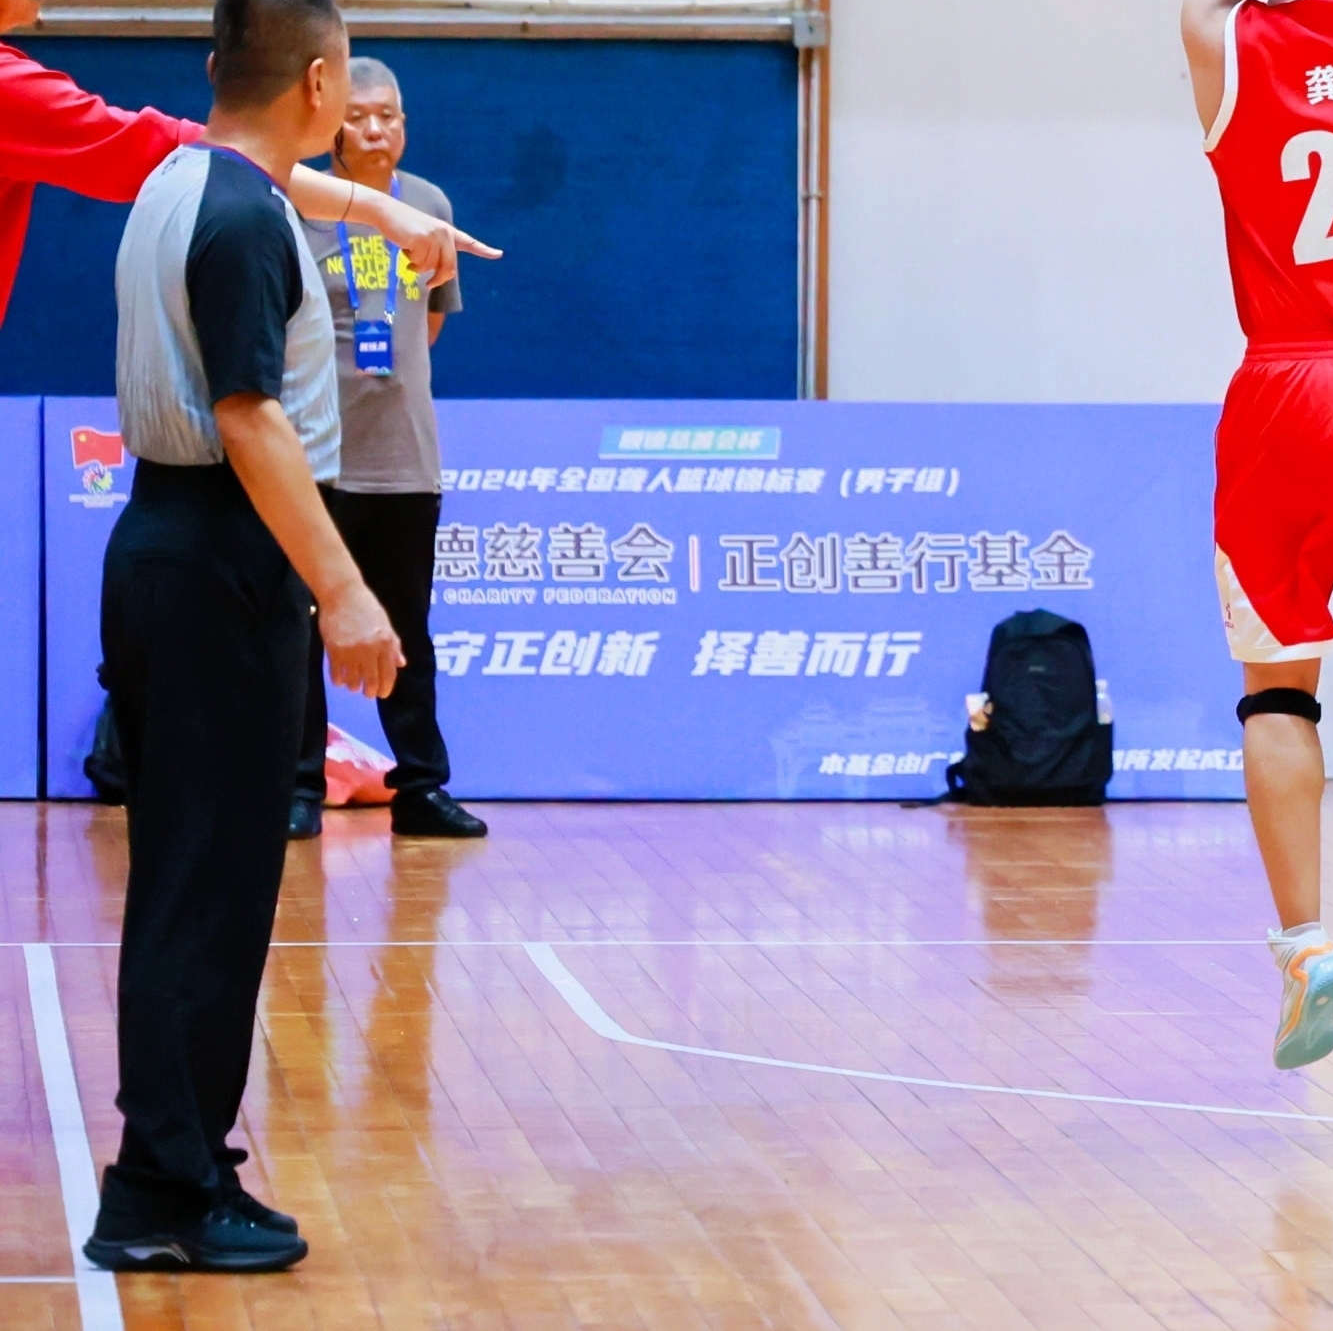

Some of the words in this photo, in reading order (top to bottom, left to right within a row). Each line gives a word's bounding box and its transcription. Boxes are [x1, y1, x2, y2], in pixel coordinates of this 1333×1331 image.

[348, 235, 384, 255] THE
[718, 530, 1095, 595] 正创善行基金
[443, 587, 538, 606] CHARITY
[542, 587, 678, 606] FEDERATION
[432, 630, 662, 677] 守正创新
[691, 630, 923, 677] 择善而行
